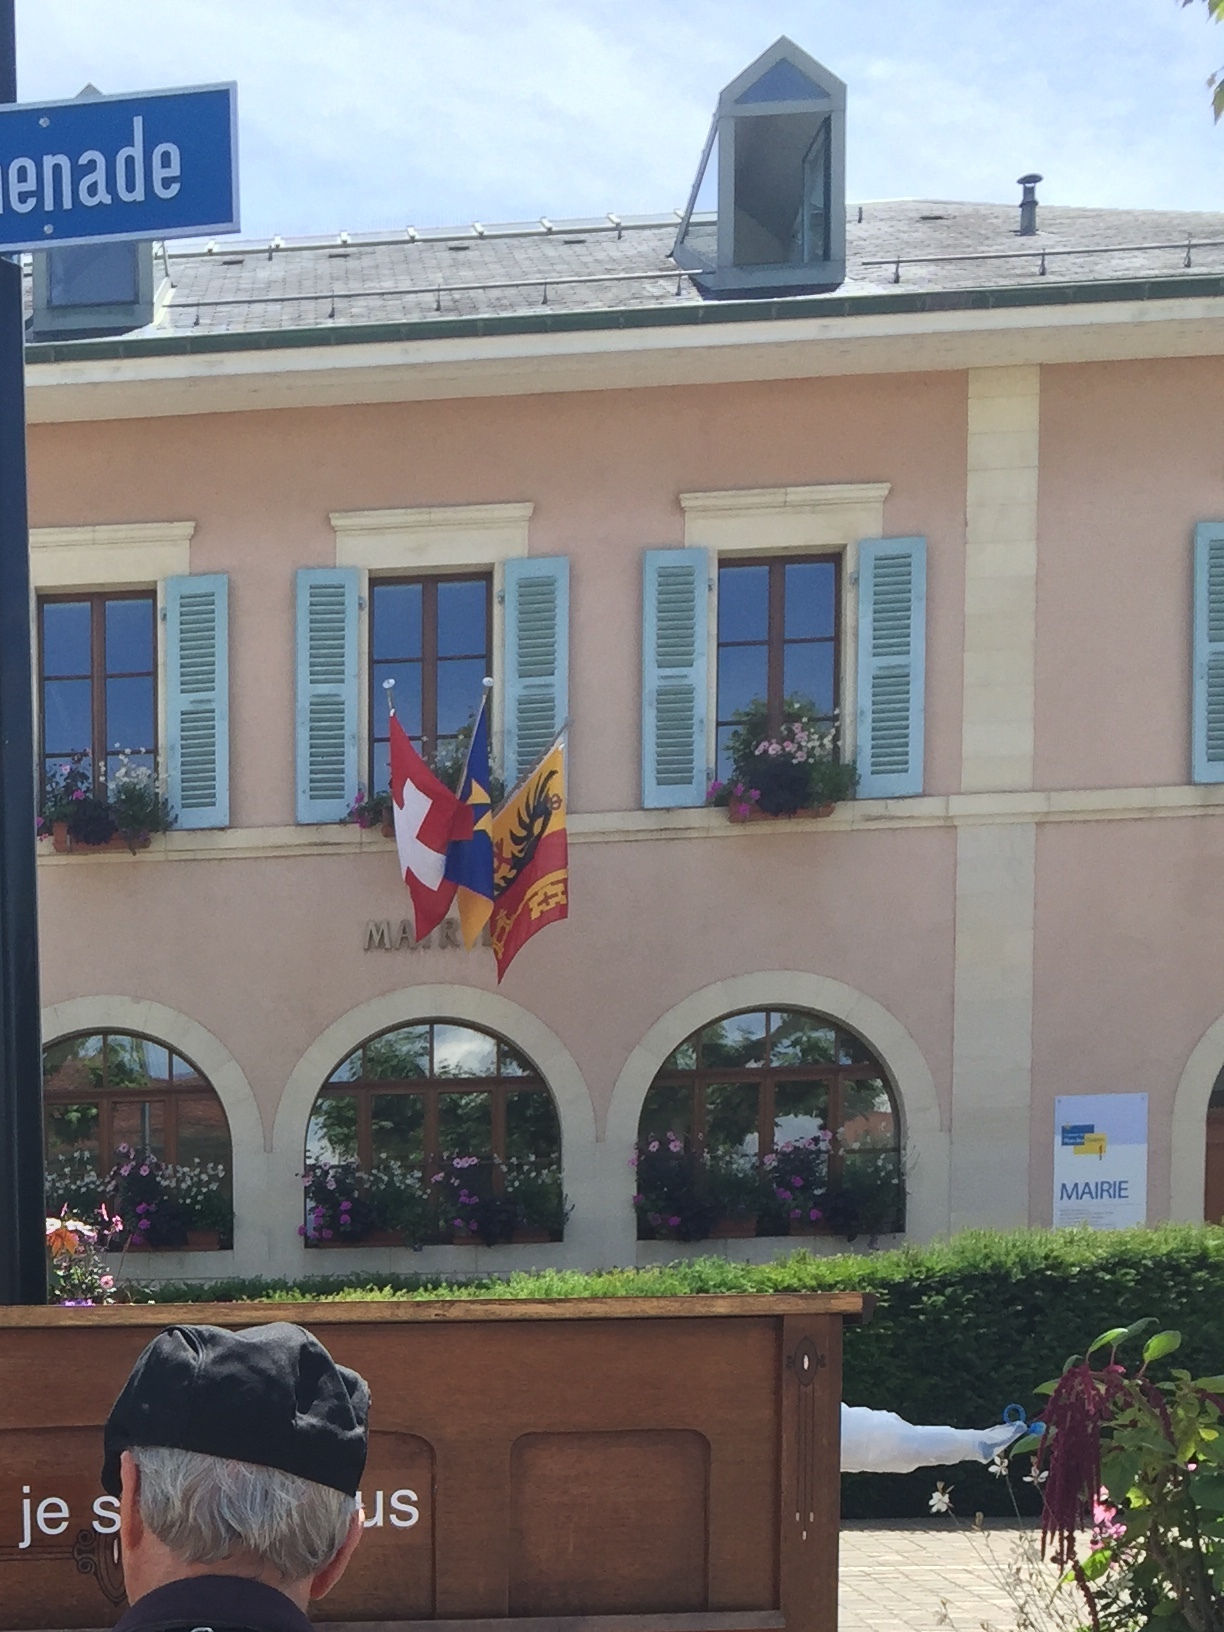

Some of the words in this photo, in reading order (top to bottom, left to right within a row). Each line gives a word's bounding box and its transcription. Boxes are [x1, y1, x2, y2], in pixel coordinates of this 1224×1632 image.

[364, 918, 492, 952] MAR
[1060, 1180, 1129, 1200] MAIRIE
[19, 1486, 70, 1548] je
[355, 1489, 419, 1528] us
